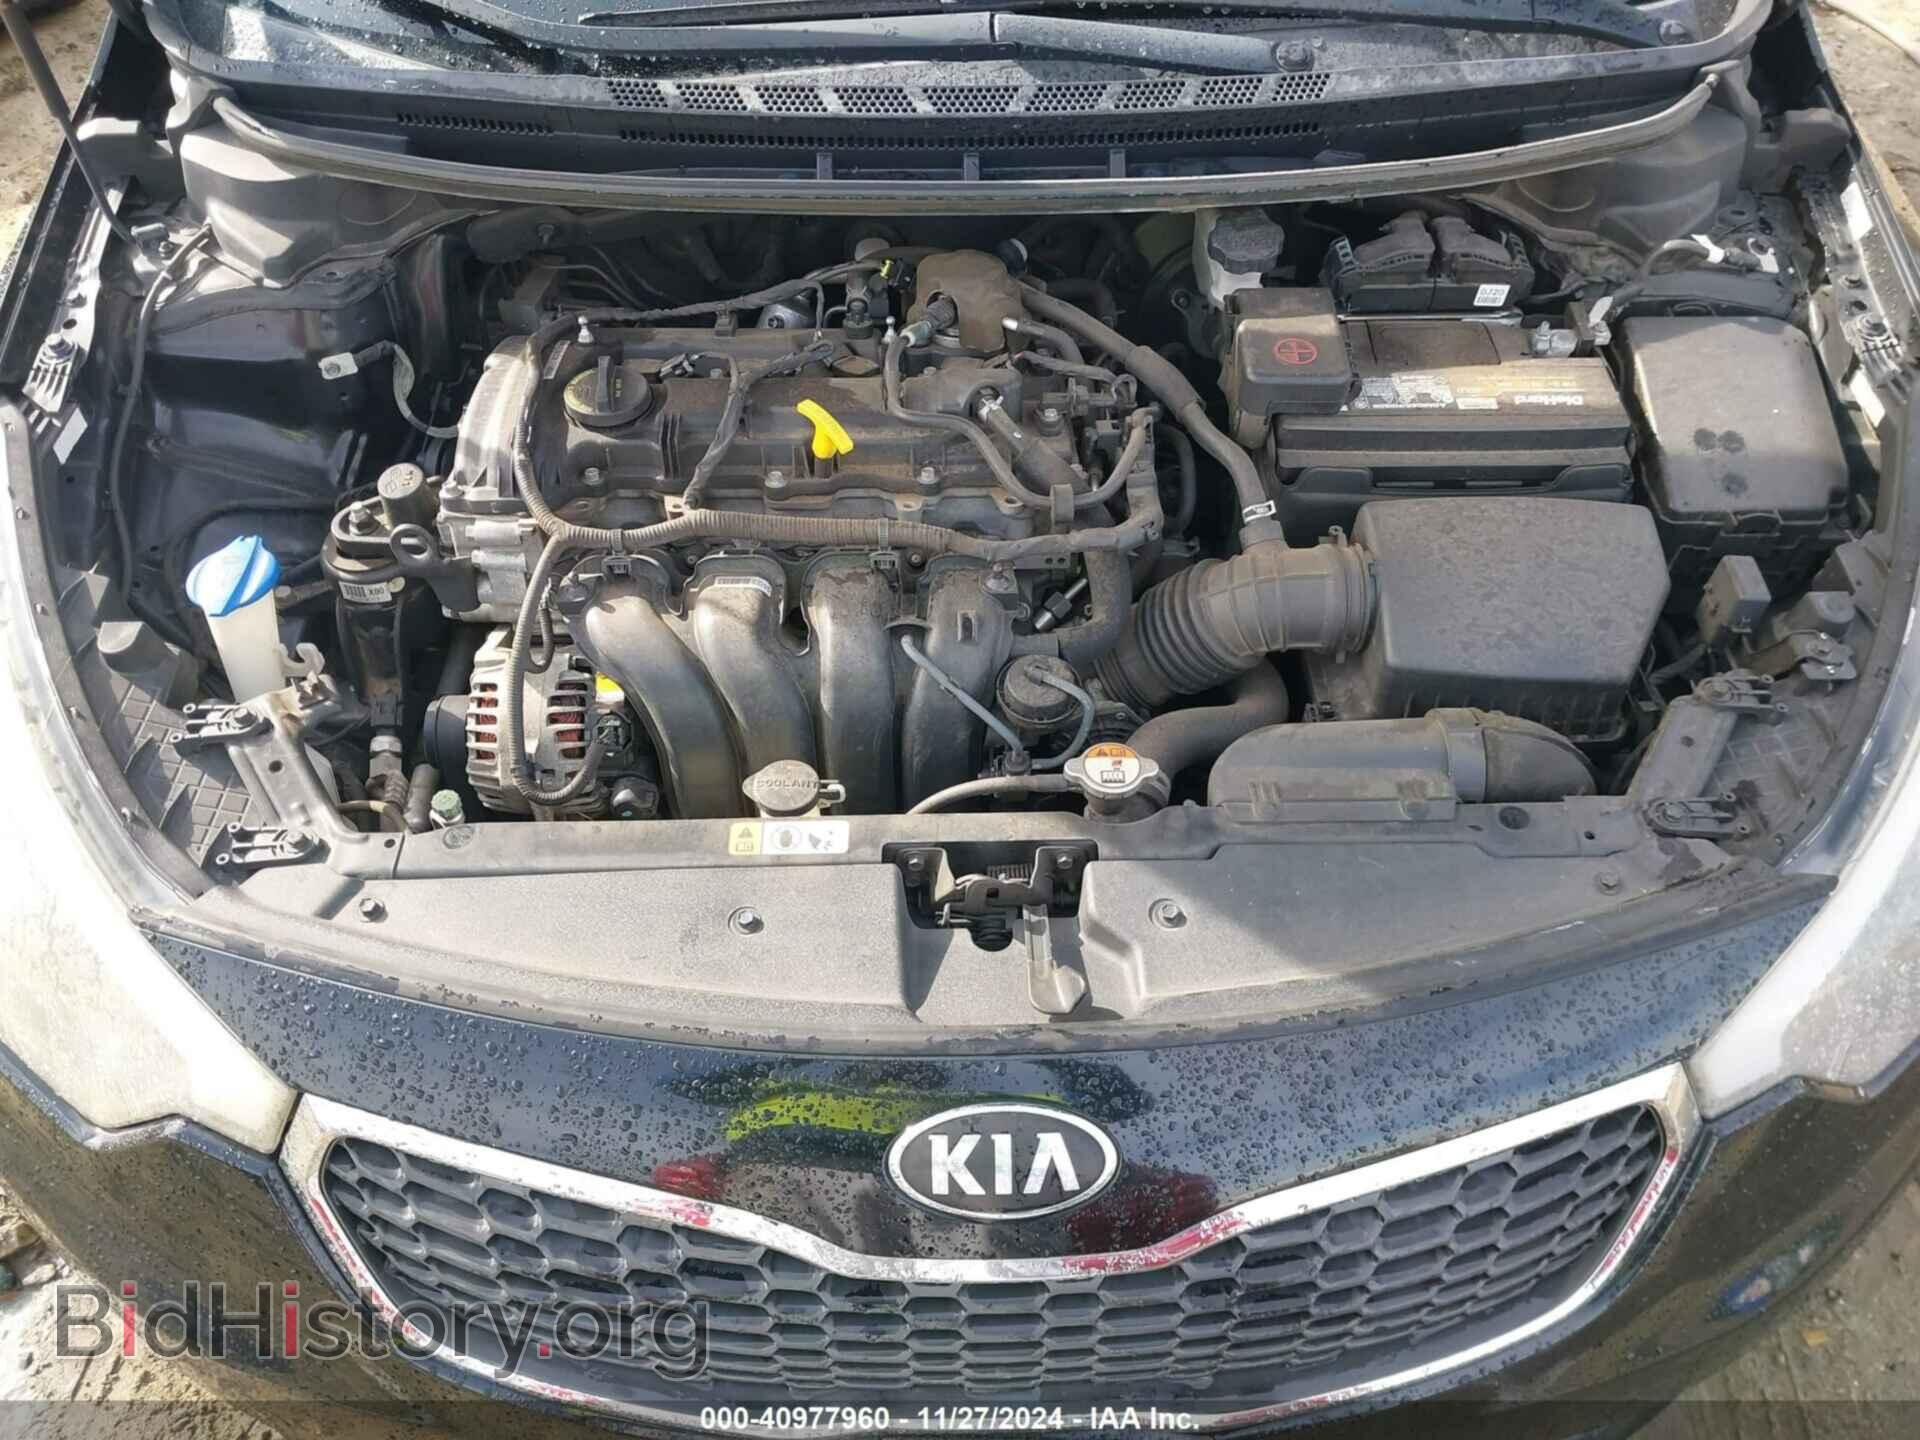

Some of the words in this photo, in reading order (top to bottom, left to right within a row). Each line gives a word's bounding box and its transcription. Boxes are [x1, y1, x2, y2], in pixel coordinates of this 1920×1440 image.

[1514, 393, 1584, 406] DieHard
[756, 778, 819, 789] COOLANT
[928, 1132, 1081, 1195] KIA
